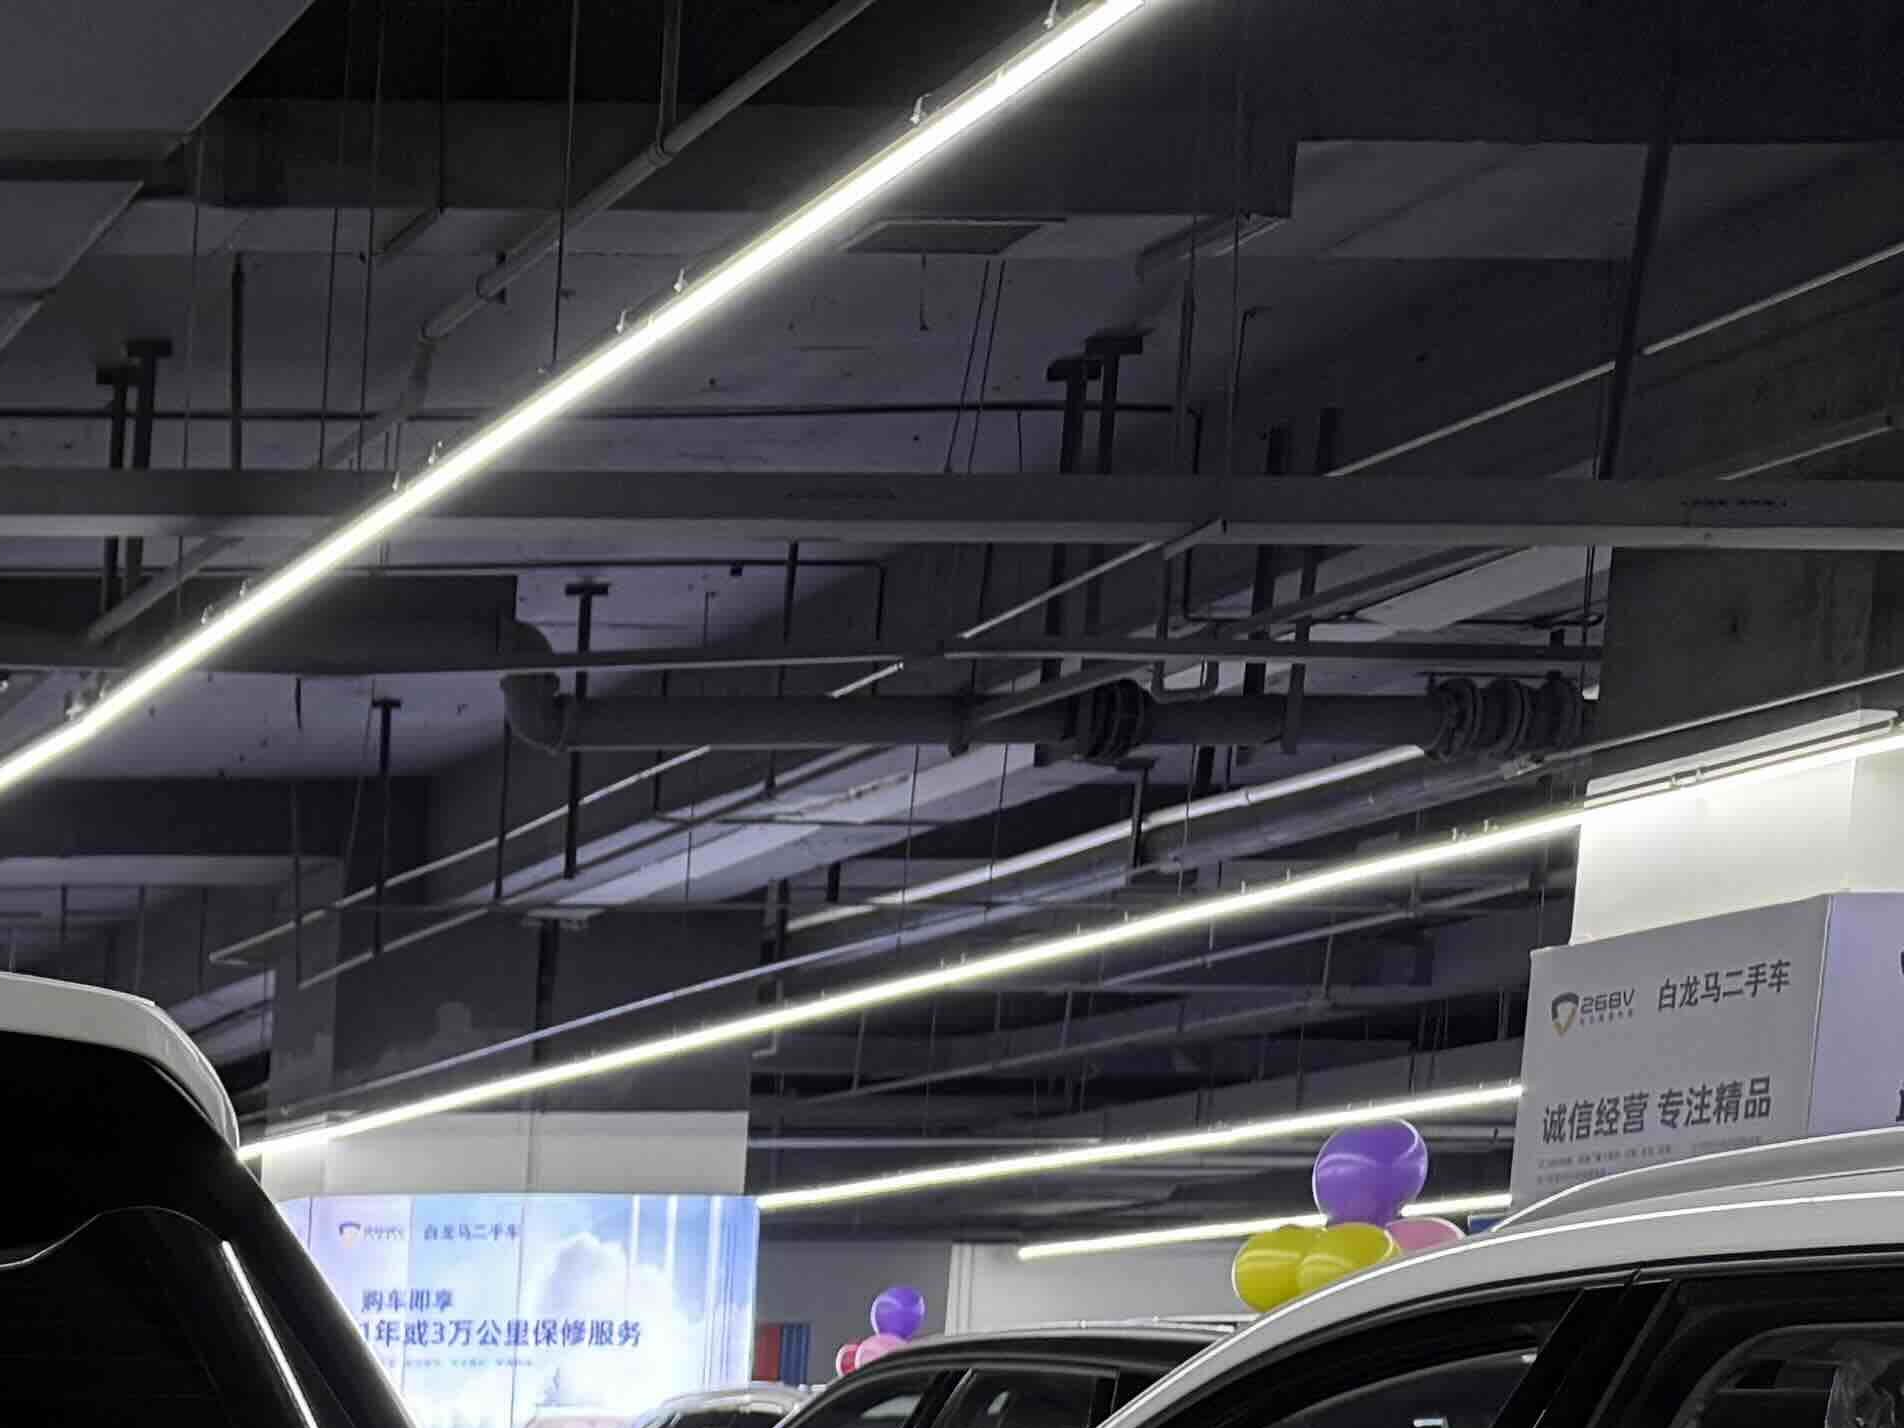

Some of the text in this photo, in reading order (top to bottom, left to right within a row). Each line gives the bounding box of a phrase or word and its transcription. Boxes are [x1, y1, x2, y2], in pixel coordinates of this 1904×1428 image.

[1657, 959, 1791, 1012] 白龙马二手车
[1542, 1075, 1771, 1145] 诚信经营 专注精品
[360, 1287, 453, 1313] 购车即享
